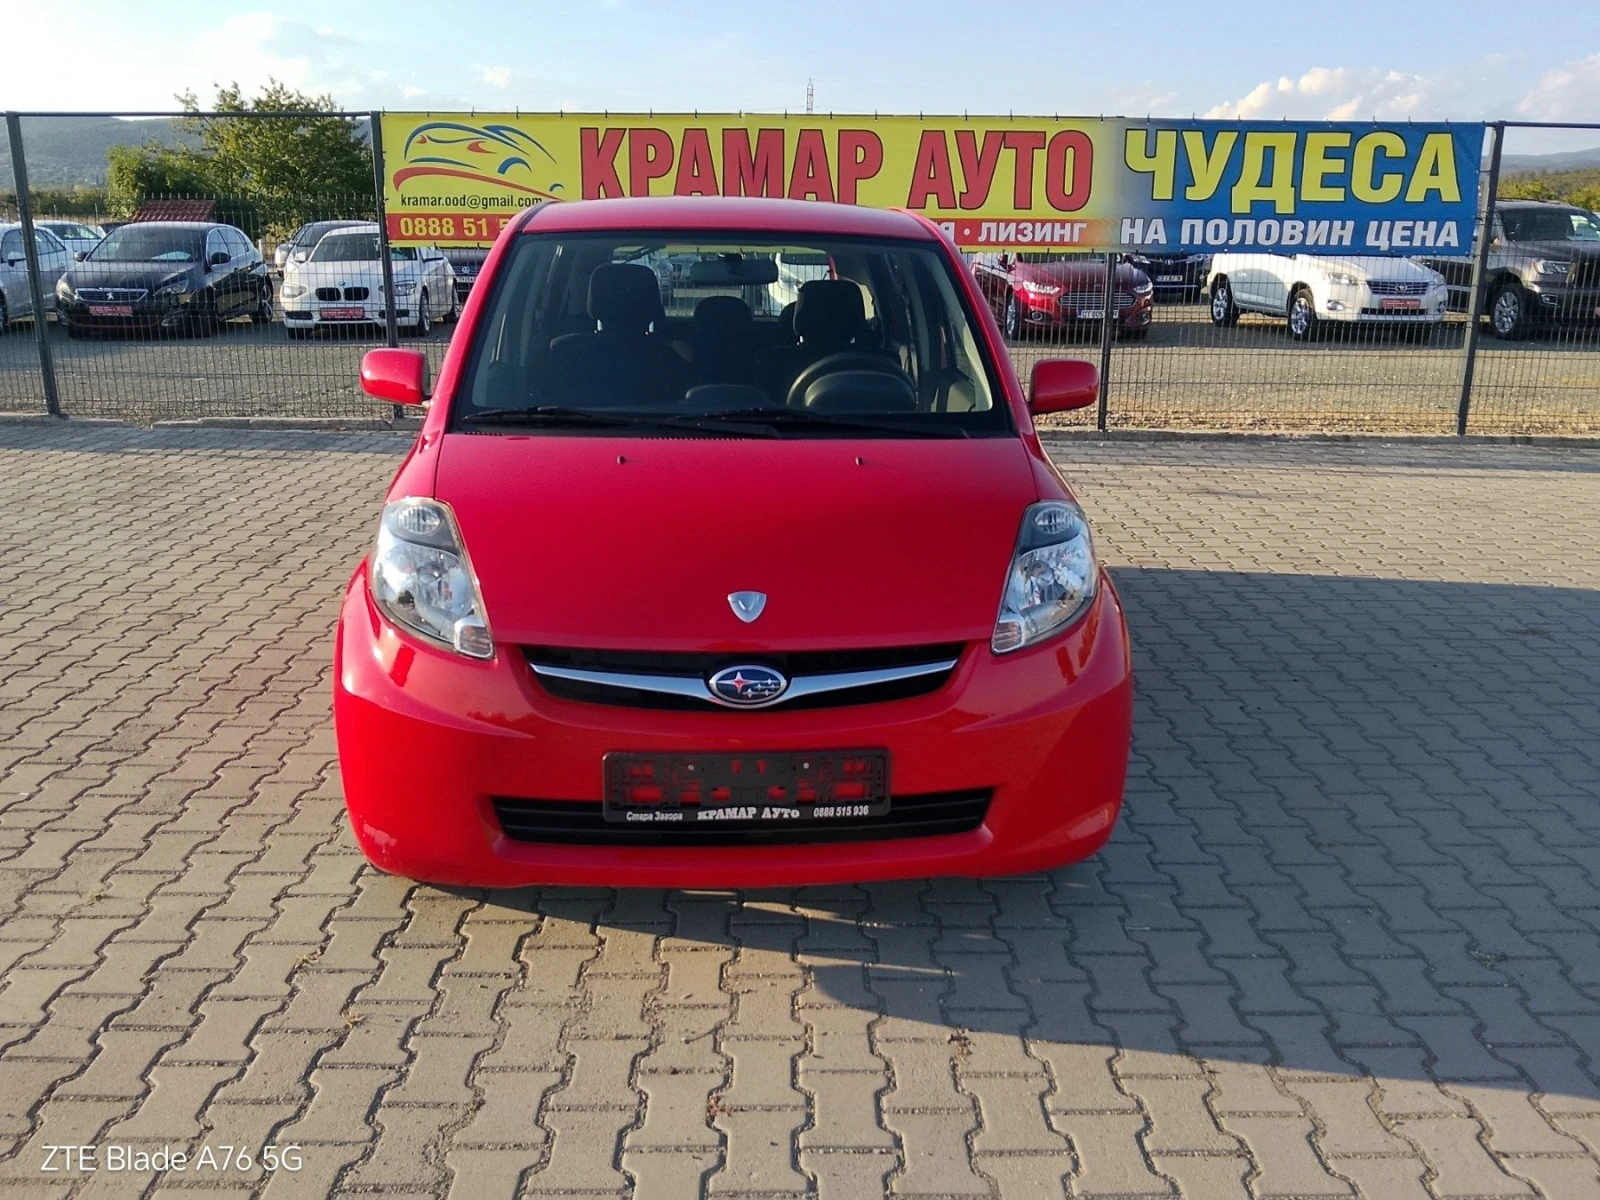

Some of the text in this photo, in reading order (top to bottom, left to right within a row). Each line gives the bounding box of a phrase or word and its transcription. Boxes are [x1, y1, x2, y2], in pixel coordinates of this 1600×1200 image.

[579, 126, 1094, 212] КРАМАР АУТО
[1123, 128, 1462, 215] ЧУДЕСА
[401, 194, 542, 209] kramar.ood@gmail.com
[400, 217, 455, 237] 0888
[463, 218, 489, 237] 51
[978, 222, 1087, 244] ЛИЗИНГ
[1119, 218, 1460, 251] НА ПОЛОВИН ЦЕНА
[813, 807, 834, 818] 0888
[836, 806, 851, 816] 515
[853, 805, 869, 816] 936
